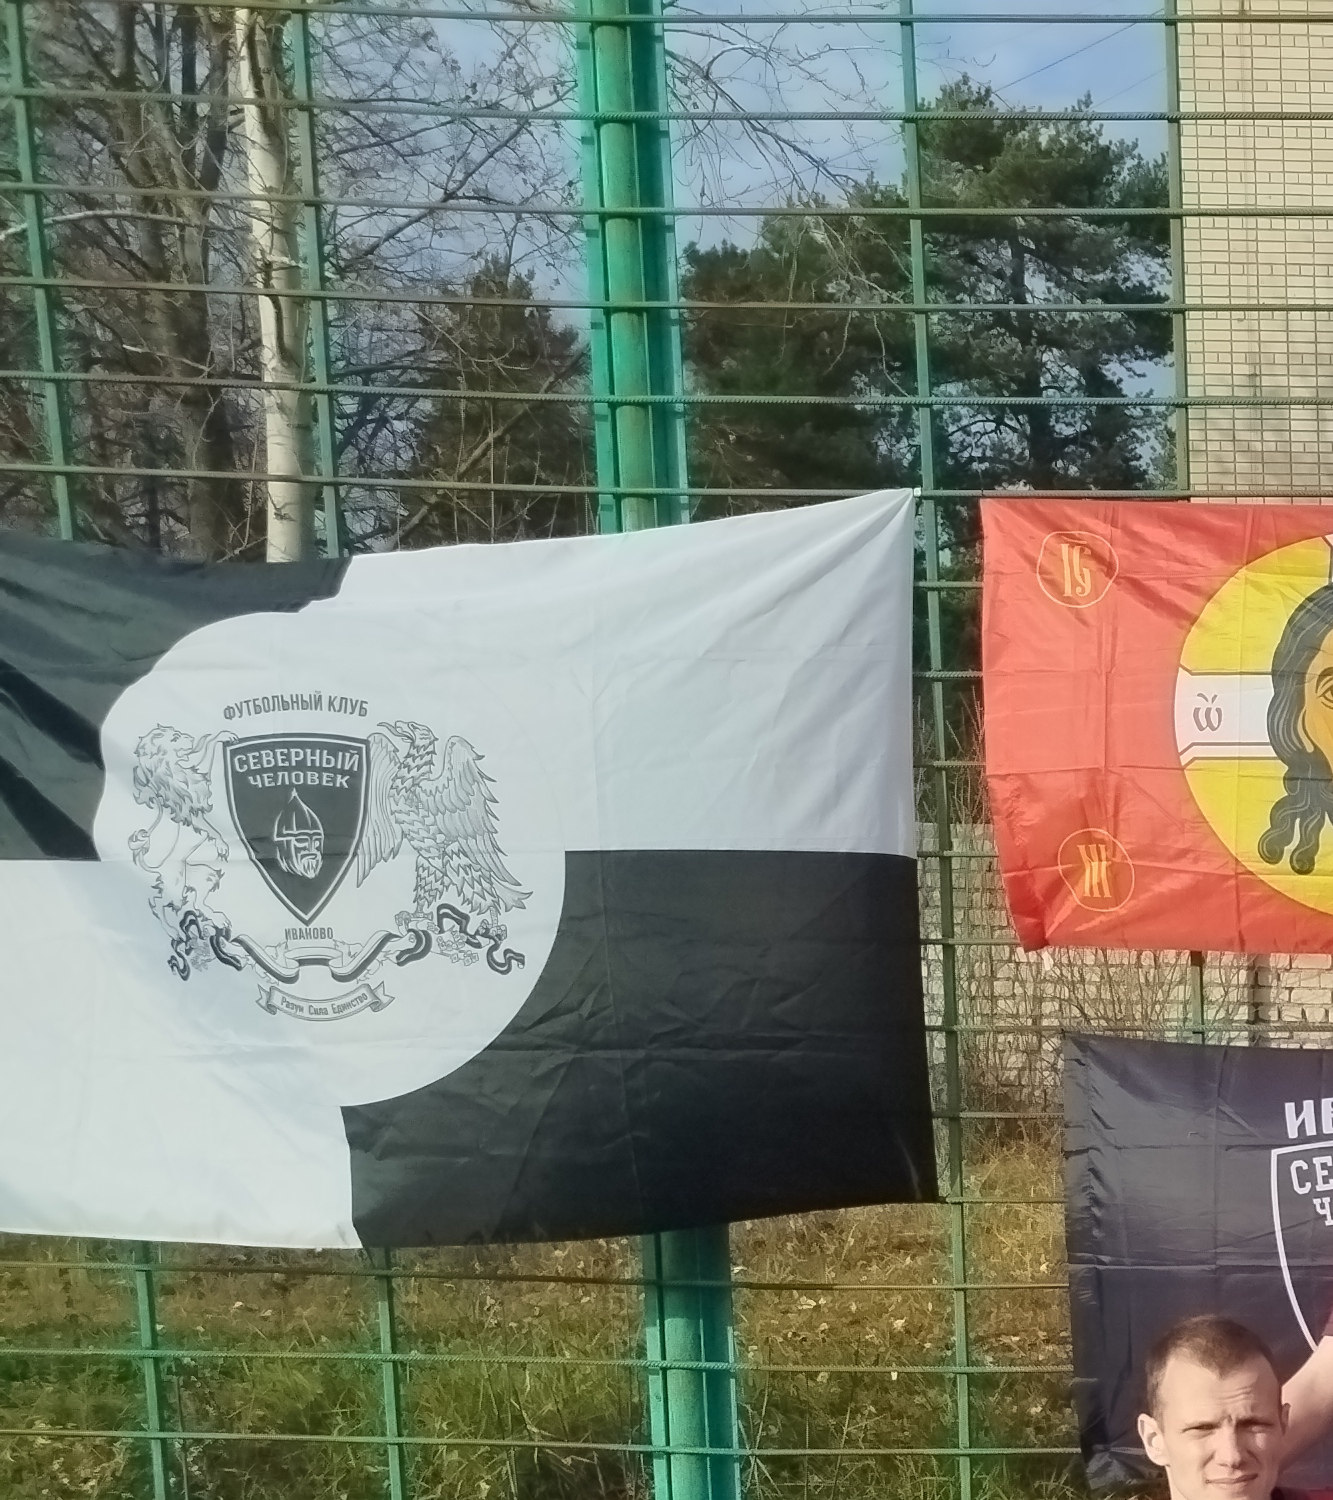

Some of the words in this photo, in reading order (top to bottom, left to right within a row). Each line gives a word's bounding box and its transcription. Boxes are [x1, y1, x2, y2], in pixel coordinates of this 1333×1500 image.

[223, 690, 323, 720] ФУТБОЛЬНЫЙ
[328, 695, 369, 717] КЛУБ
[234, 749, 360, 773] СЕВЕРНЫЙ
[248, 771, 350, 788] ЧЕЛОВЕК
[285, 927, 334, 940] ИВАНОВО
